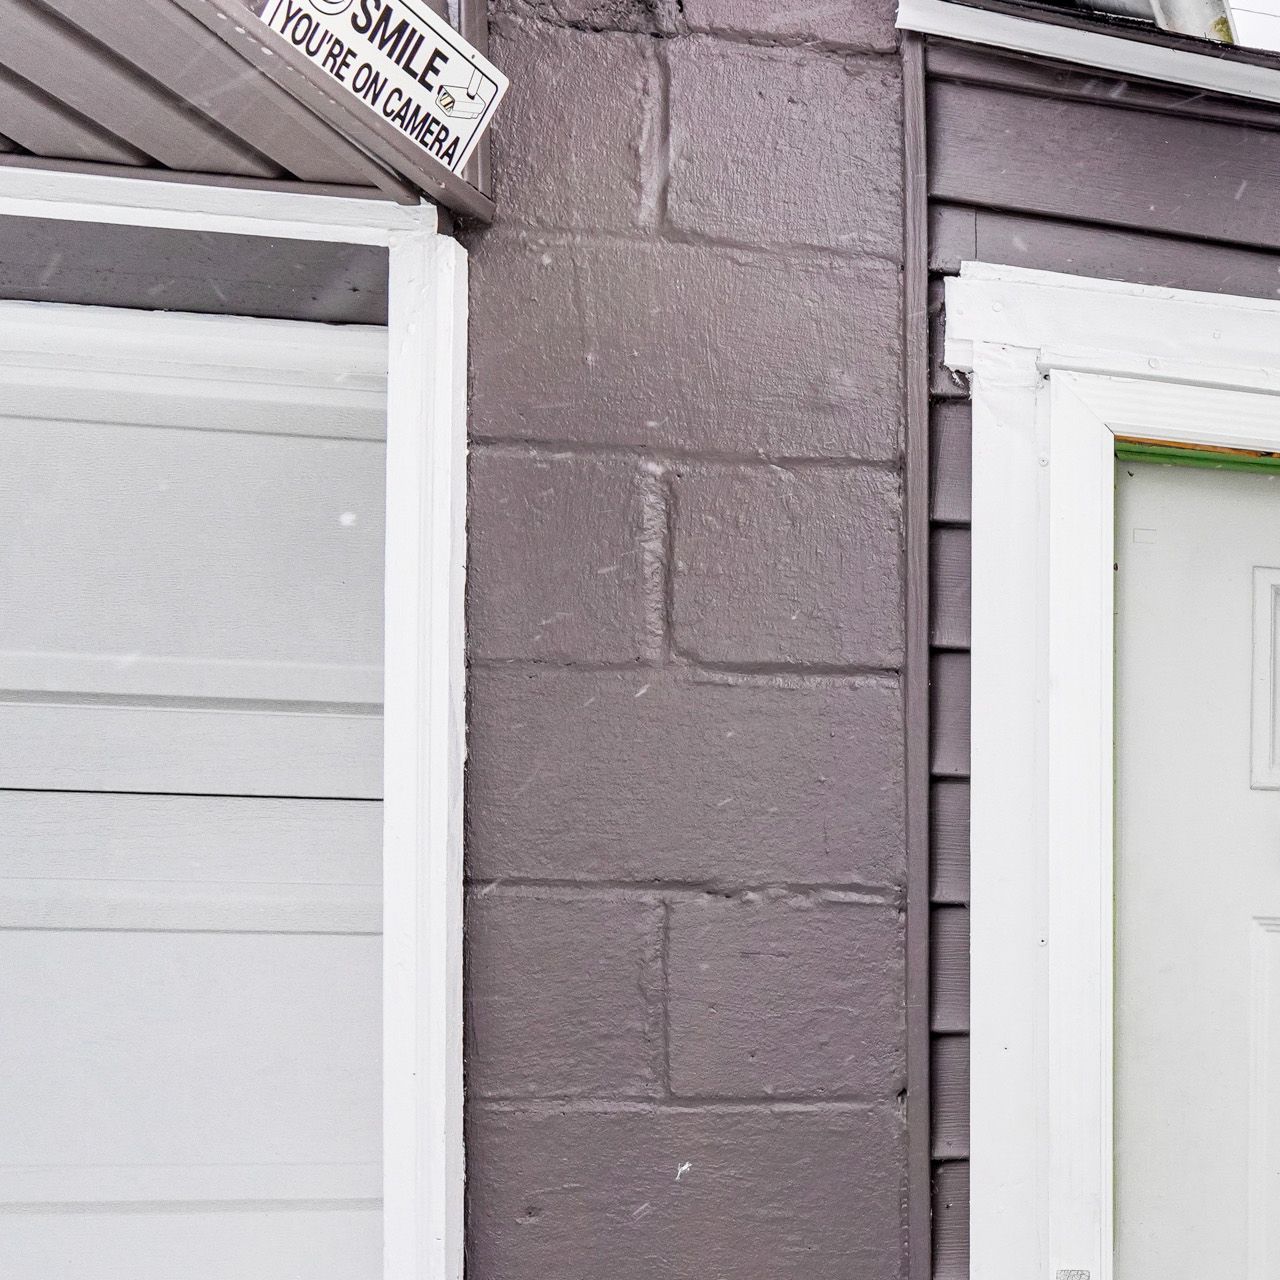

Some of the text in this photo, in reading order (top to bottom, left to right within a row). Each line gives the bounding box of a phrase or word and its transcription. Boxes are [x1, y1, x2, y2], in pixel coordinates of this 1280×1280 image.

[279, 0, 461, 167] YOU'RE ON CAMERA
[350, 0, 450, 93] SMILE
